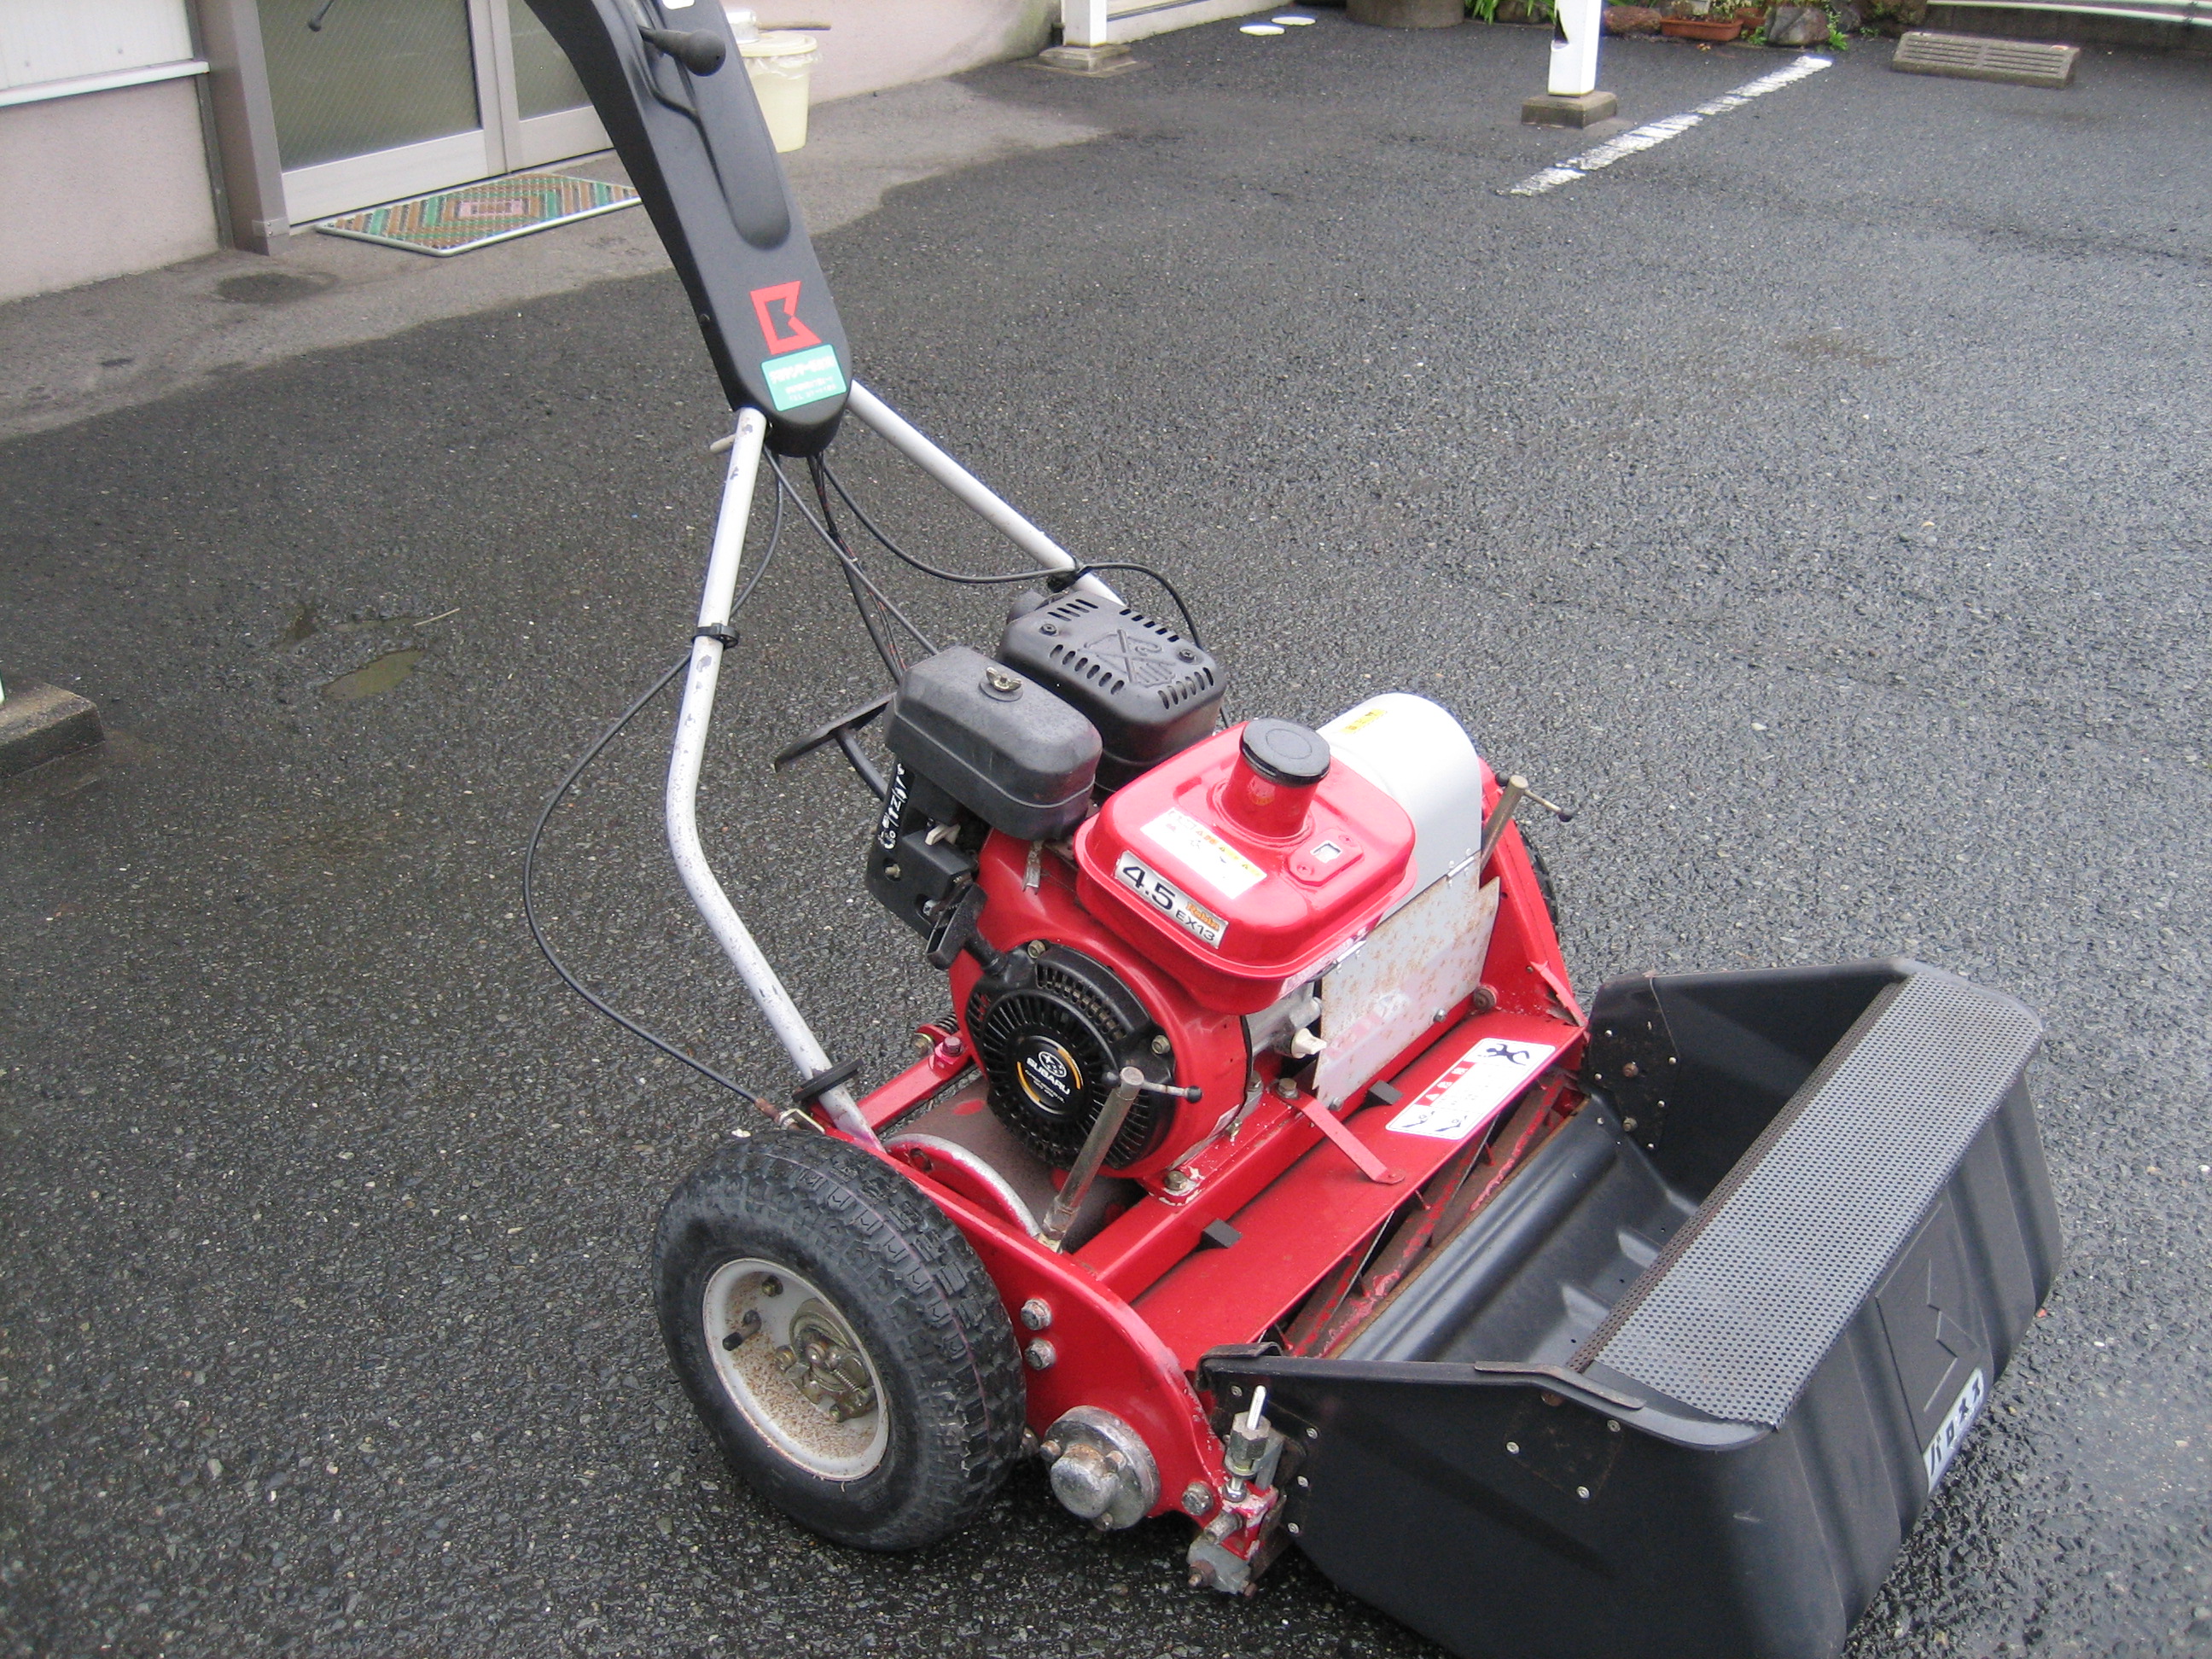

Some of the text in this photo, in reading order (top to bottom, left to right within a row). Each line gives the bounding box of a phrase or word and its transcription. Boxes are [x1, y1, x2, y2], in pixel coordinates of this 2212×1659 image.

[1122, 865, 1176, 911] 4.5
[1175, 910, 1216, 941] EX13
[1026, 1057, 1071, 1095] SUBARU
